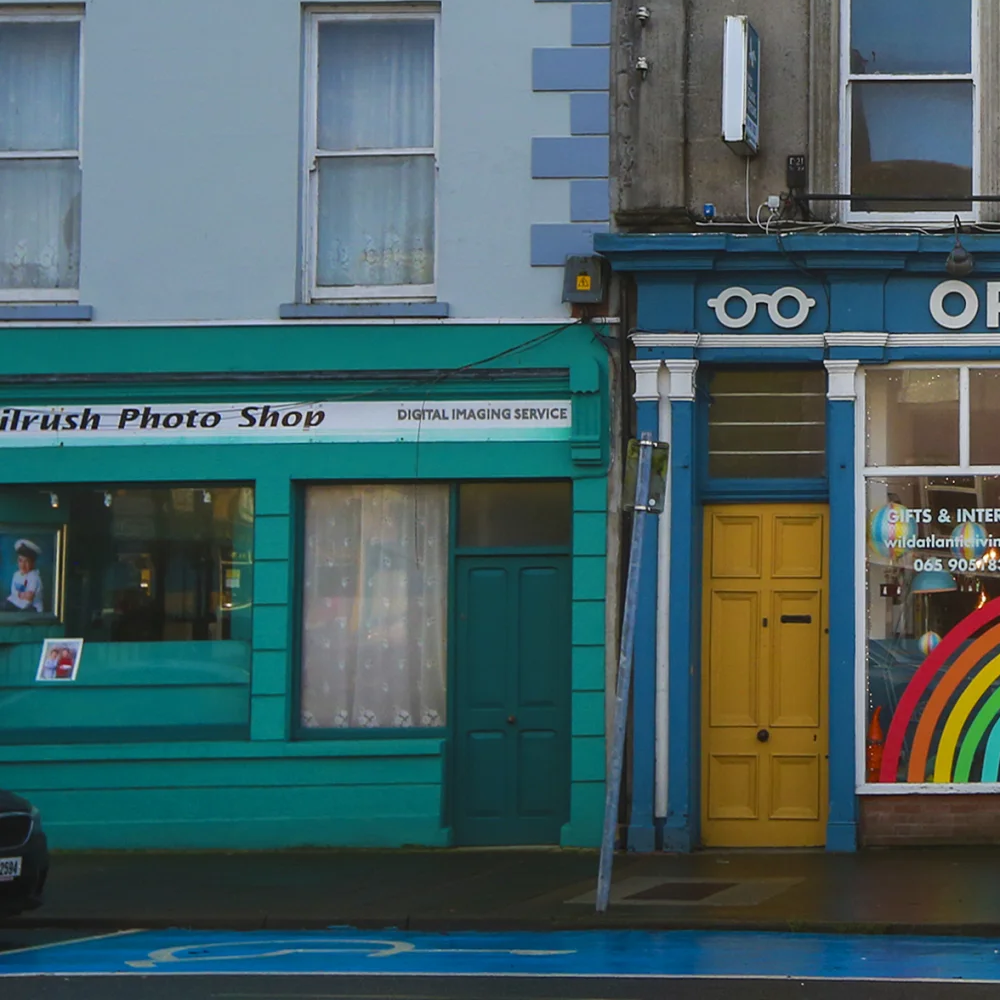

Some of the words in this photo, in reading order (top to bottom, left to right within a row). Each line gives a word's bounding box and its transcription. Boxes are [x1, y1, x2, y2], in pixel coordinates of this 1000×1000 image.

[117, 406, 222, 430] Photo
[237, 404, 327, 431] Shop
[397, 408, 449, 421] DIGITAL
[451, 408, 511, 421] IMAGING
[513, 407, 568, 420] SERVICE
[887, 508, 932, 524] GIFTS
[937, 508, 952, 524] &
[913, 559, 943, 573] 065
